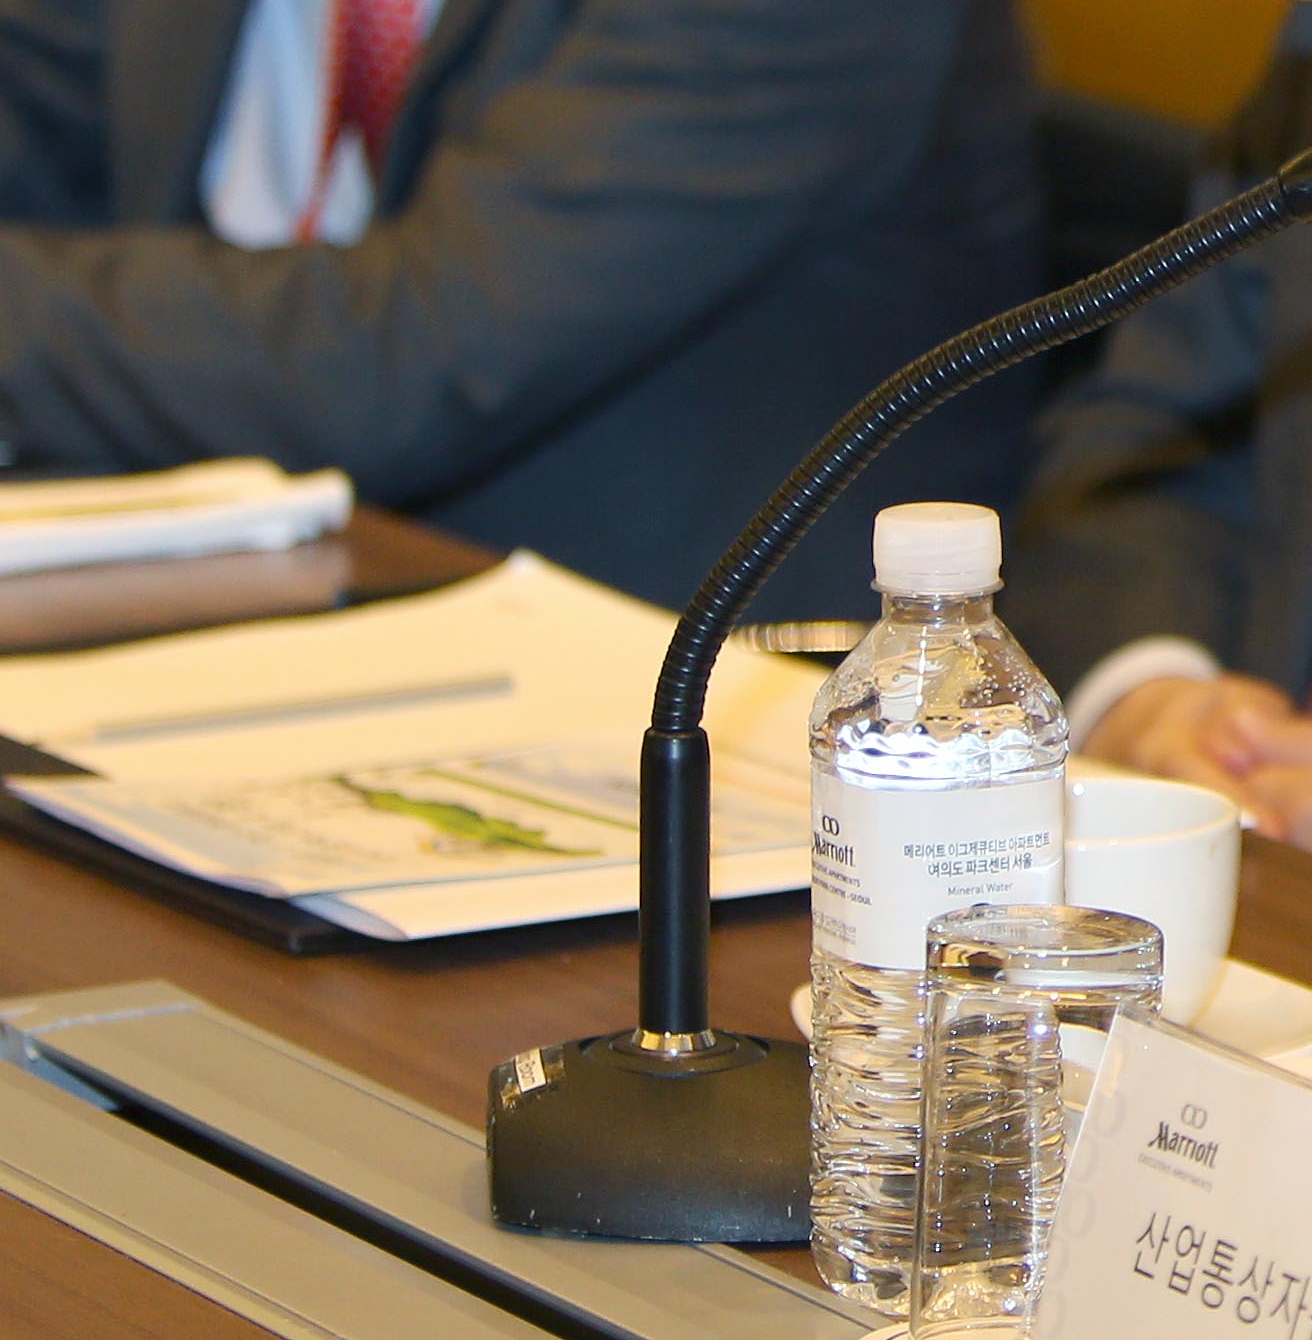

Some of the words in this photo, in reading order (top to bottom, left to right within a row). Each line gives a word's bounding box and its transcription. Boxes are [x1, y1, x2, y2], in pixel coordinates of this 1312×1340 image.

[812, 831, 855, 867] Marriott
[903, 843, 946, 859] 메리어트
[948, 838, 1008, 857] 이그제큐티브
[928, 860, 964, 878] 여의도
[965, 856, 1011, 875] 파크센터
[1012, 852, 1033, 870] 서울
[947, 884, 984, 896] Mineral
[985, 882, 1014, 894] Water
[1147, 1121, 1219, 1169] Marriott
